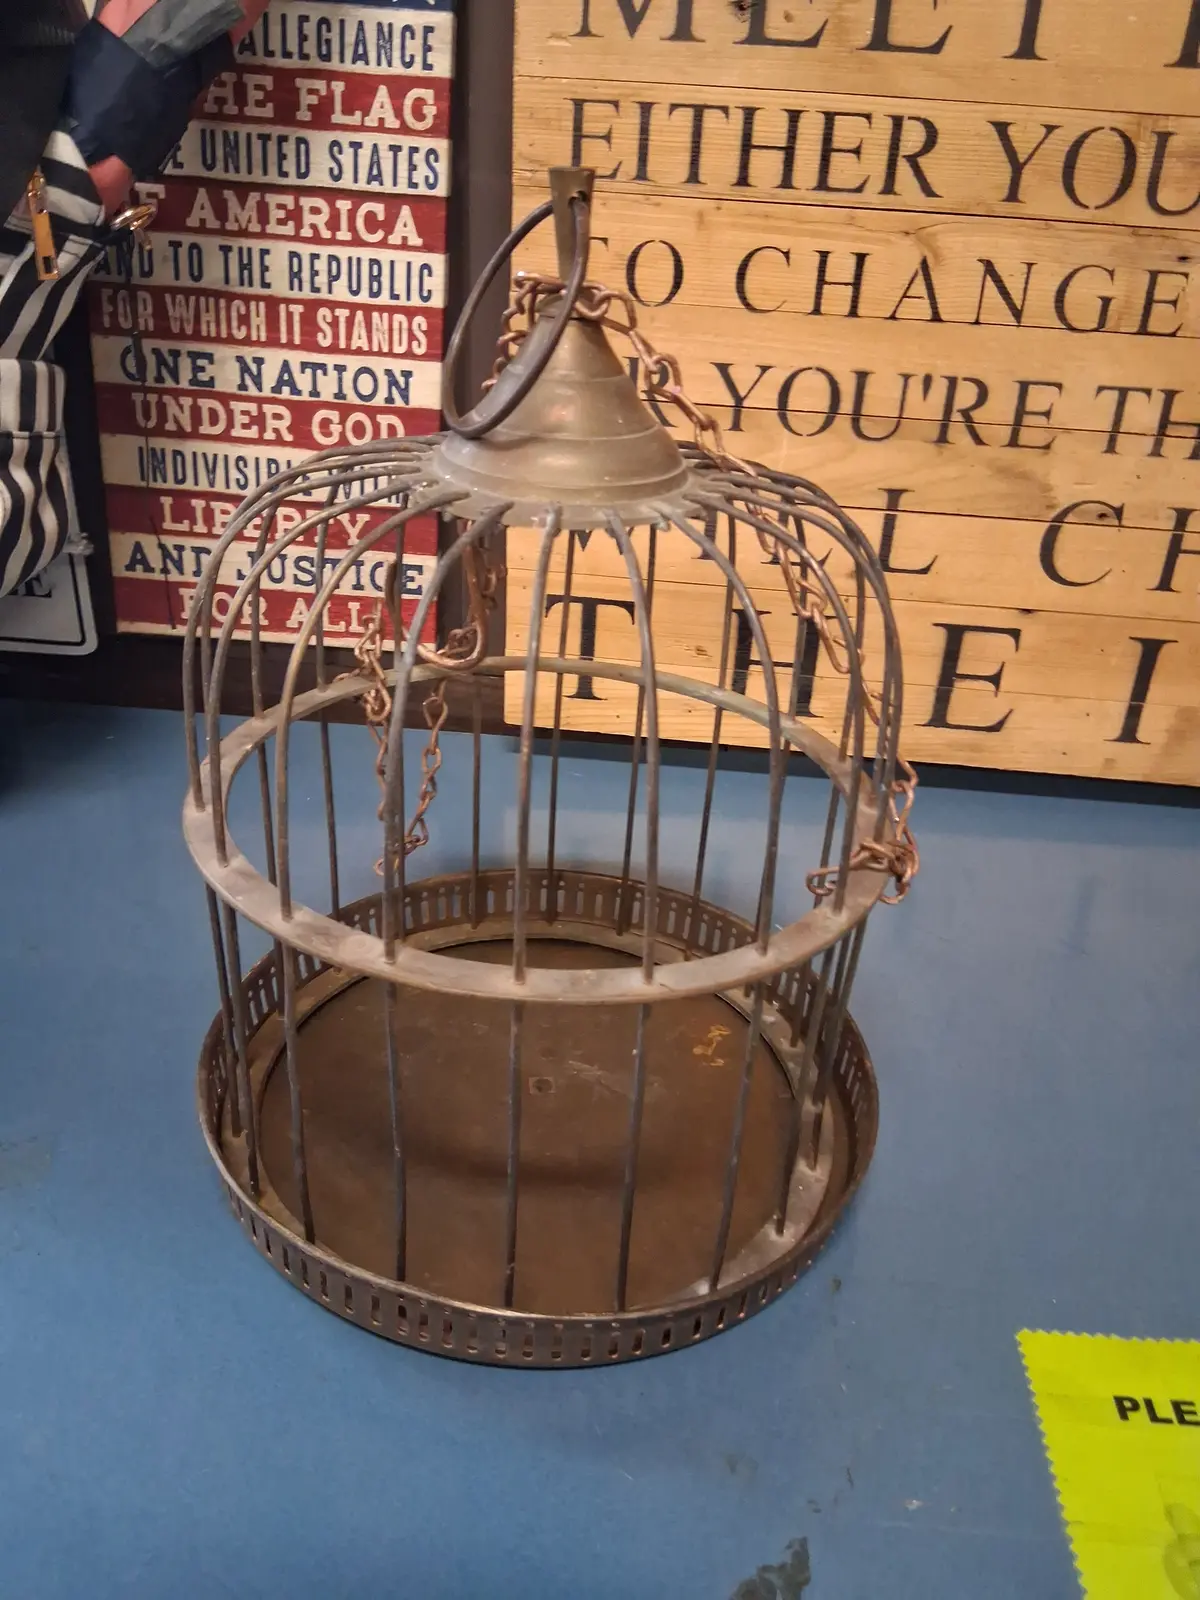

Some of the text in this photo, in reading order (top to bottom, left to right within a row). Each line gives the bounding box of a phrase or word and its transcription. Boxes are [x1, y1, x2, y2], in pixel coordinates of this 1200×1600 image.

[203, 71, 438, 131] HE FLAG
[200, 128, 311, 180] UNITED
[329, 139, 440, 192] STATES
[570, 98, 1200, 217] EITHER YOU
[185, 187, 423, 247] AMERICA
[168, 239, 204, 283] TO
[218, 244, 272, 289] THE
[289, 250, 433, 303] REPUBLIC
[589, 235, 1190, 337] O CHANGE
[101, 287, 428, 356] FOR WHICH IT STANDS
[120, 344, 414, 406] ONE NATION
[710, 362, 1063, 451] YOU'RE
[131, 392, 406, 446] UNDER GOD
[1112, 1394, 1200, 1427] PLE
